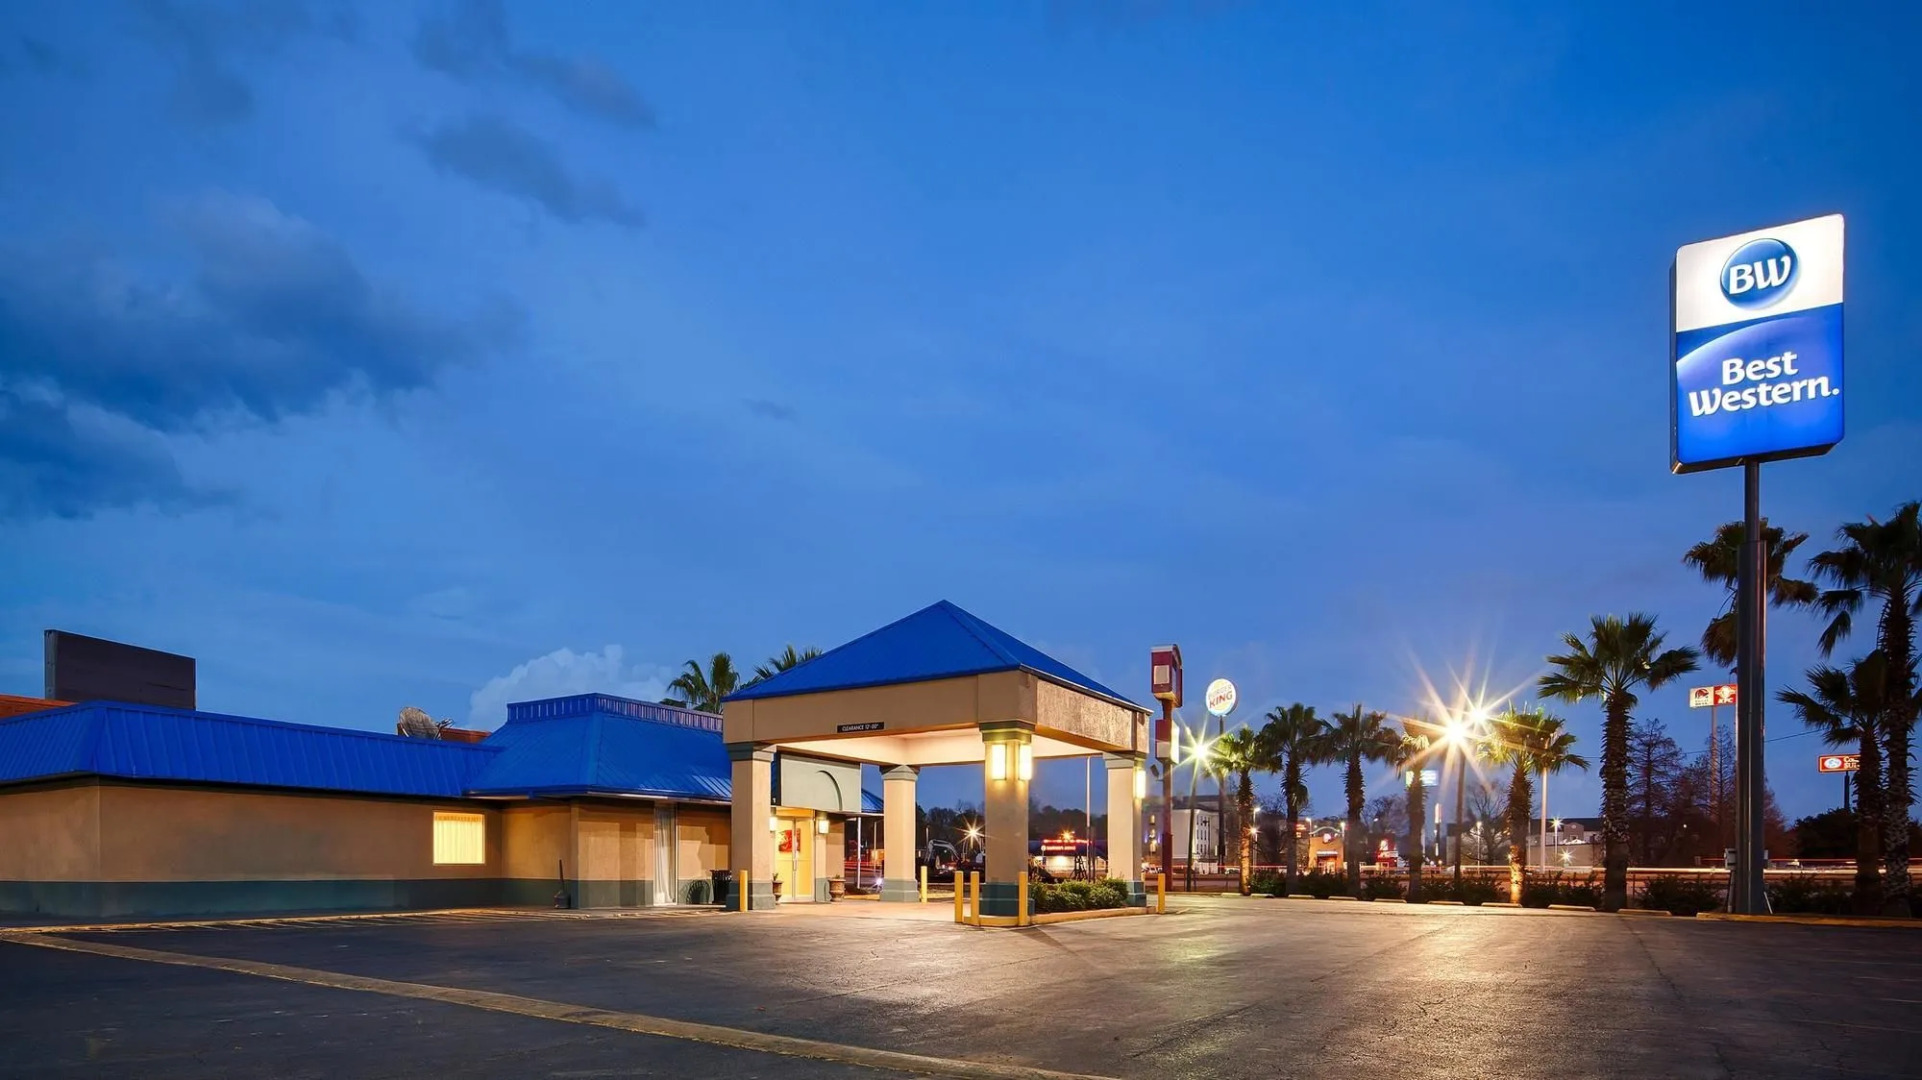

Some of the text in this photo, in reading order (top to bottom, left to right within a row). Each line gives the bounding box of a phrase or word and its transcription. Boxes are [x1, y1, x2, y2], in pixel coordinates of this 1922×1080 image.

[1728, 255, 1792, 295] BW
[1721, 351, 1799, 385] Best
[1688, 375, 1840, 417] Western.
[1209, 690, 1233, 709] KING
